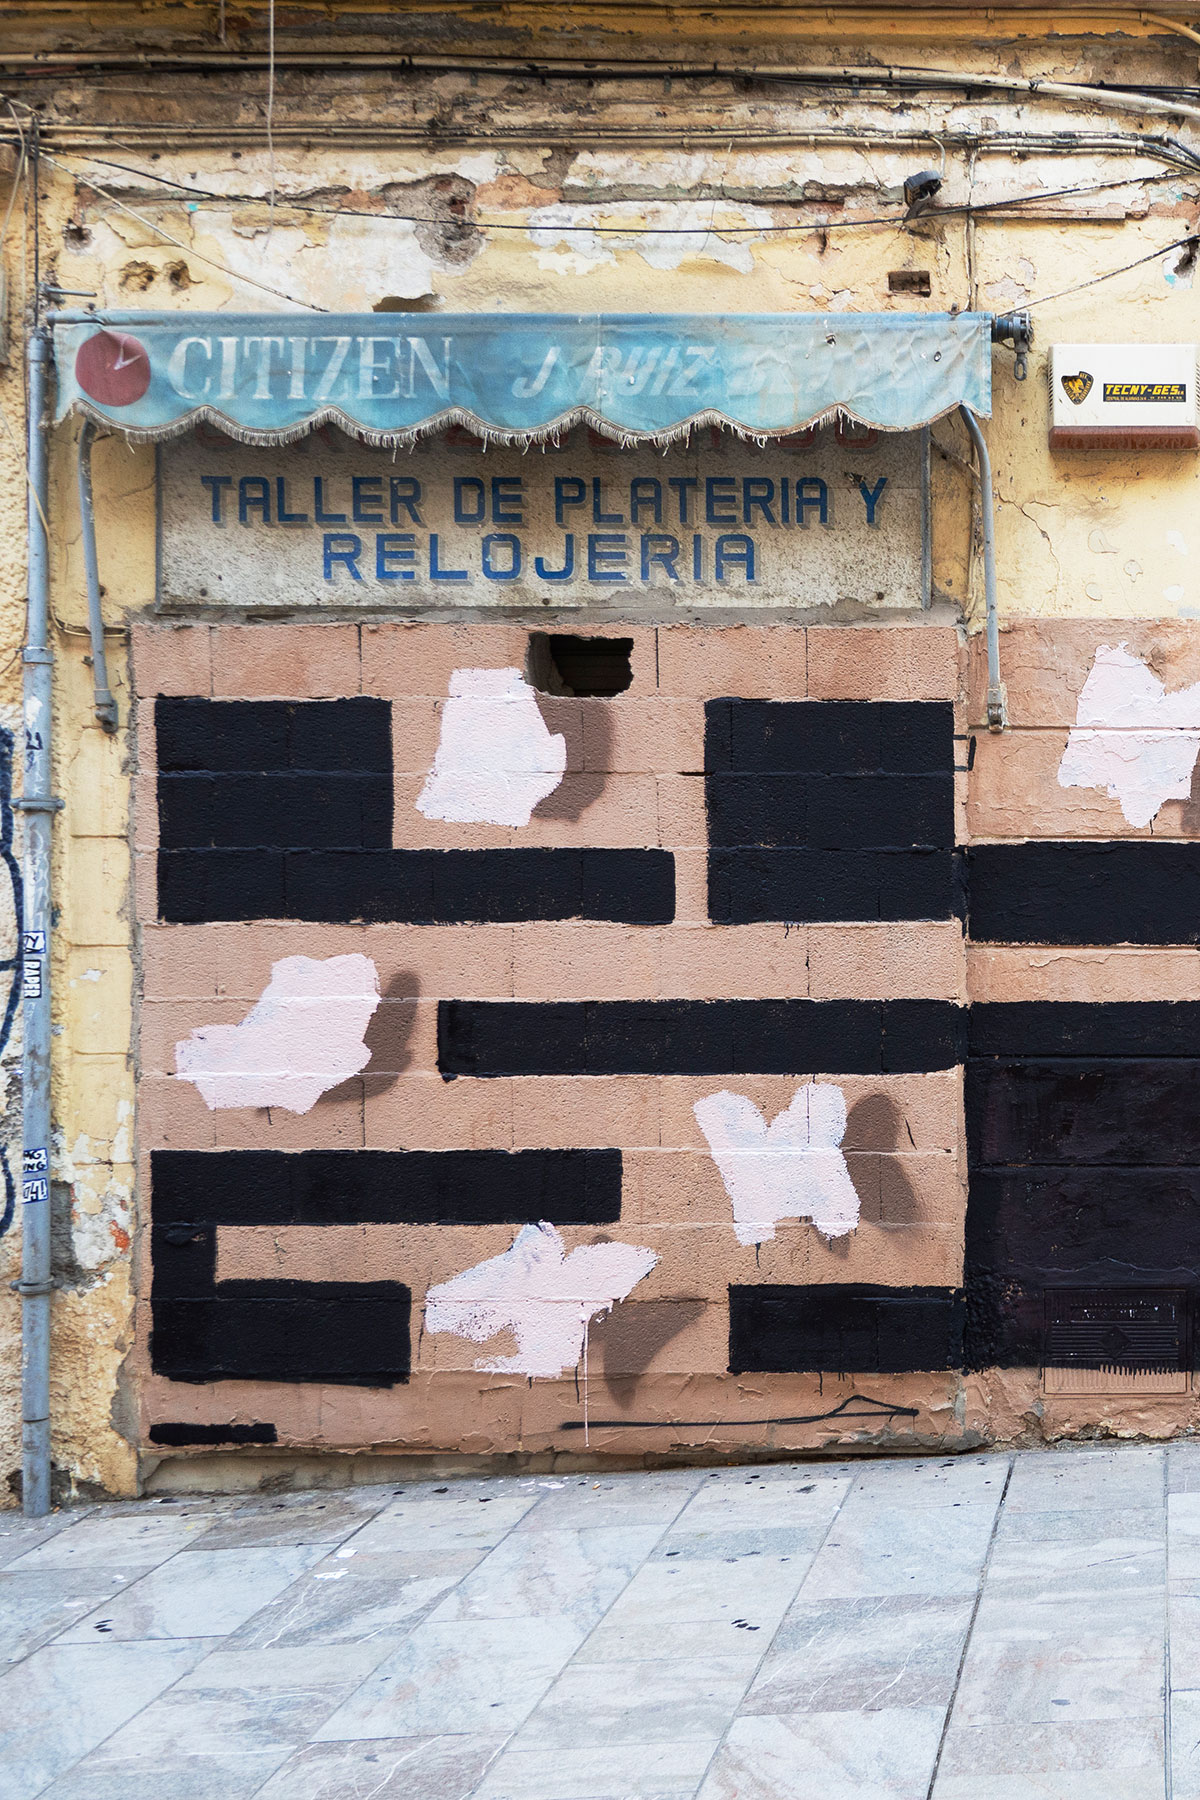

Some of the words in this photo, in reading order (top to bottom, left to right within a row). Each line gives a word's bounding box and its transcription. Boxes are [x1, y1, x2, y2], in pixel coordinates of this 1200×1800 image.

[167, 336, 454, 400] CITIZEN
[583, 345, 716, 399] RUIZ
[1105, 384, 1180, 395] TECNY-GES
[201, 475, 427, 526] TALLER
[453, 475, 527, 527] DE
[554, 476, 832, 527] PLATERIA
[859, 476, 890, 525] Y
[323, 532, 758, 582] RELOJERIA
